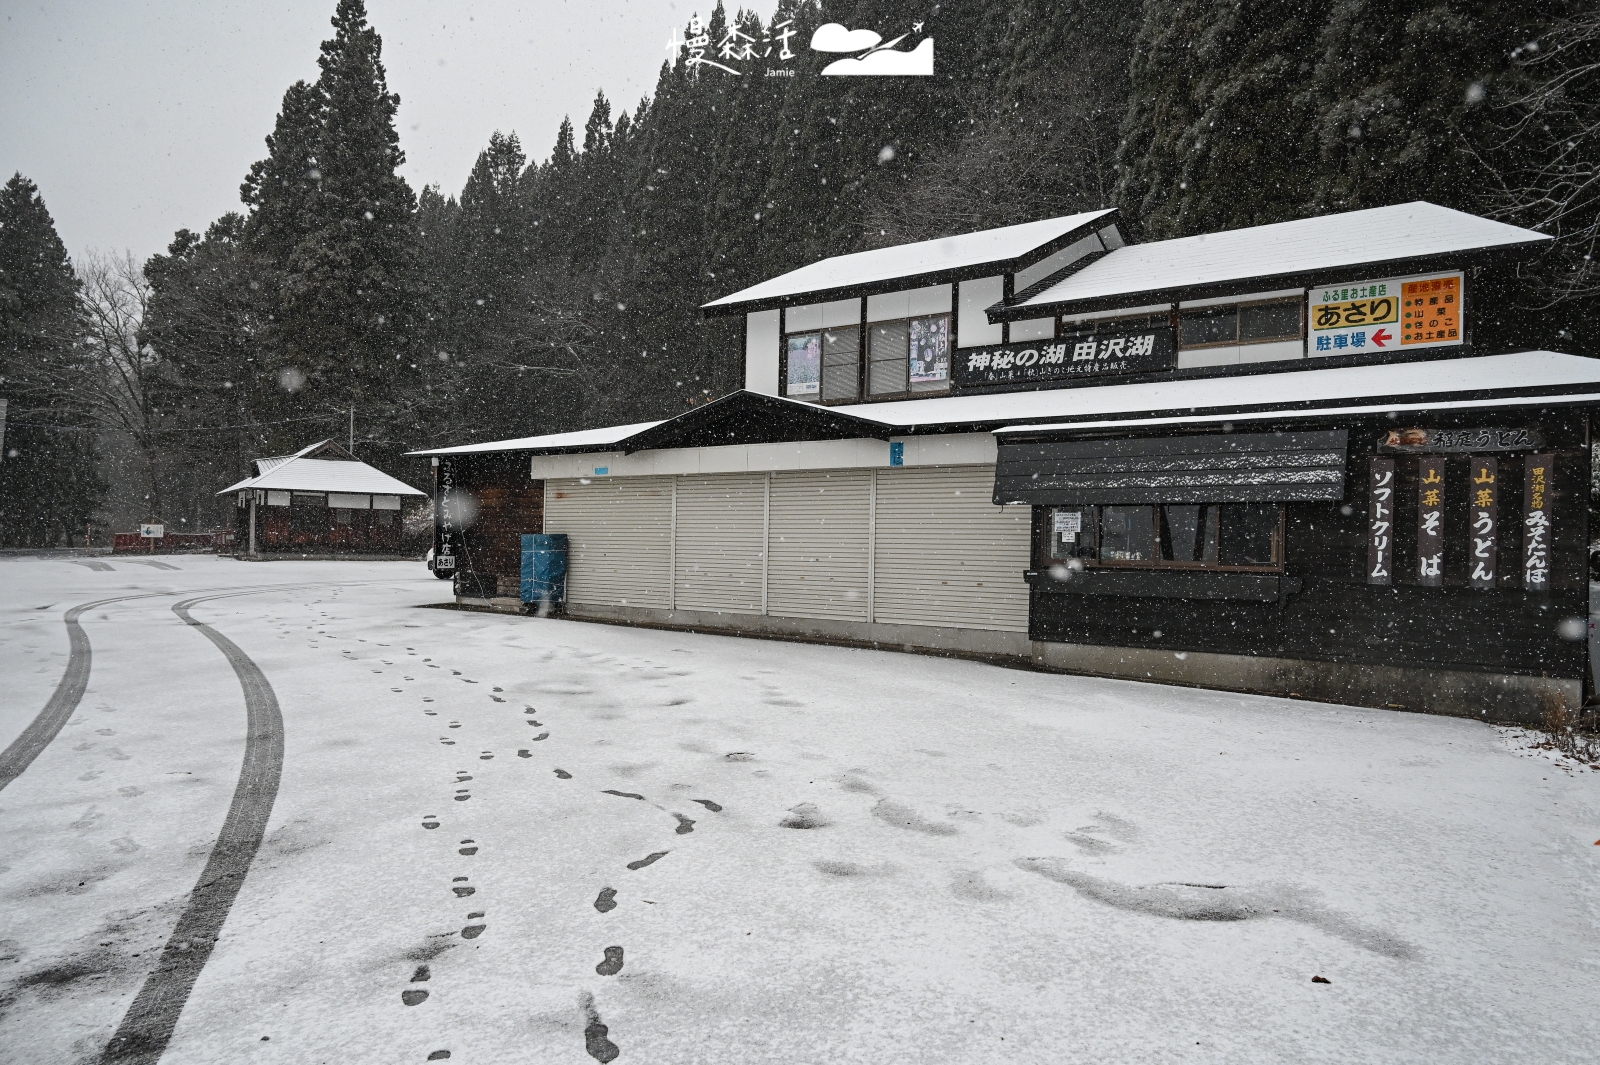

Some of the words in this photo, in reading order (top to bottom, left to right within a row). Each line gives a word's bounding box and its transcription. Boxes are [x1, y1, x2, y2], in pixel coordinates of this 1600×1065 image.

[1322, 284, 1387, 302] ふる里お土産店
[1317, 298, 1392, 327] あさり
[967, 343, 1066, 372] 神秘の湖
[1072, 334, 1155, 362] 田沢湖
[1316, 331, 1367, 351] 駐車場
[1371, 472, 1393, 577] ソフトクリーム
[437, 558, 454, 568] あさり
